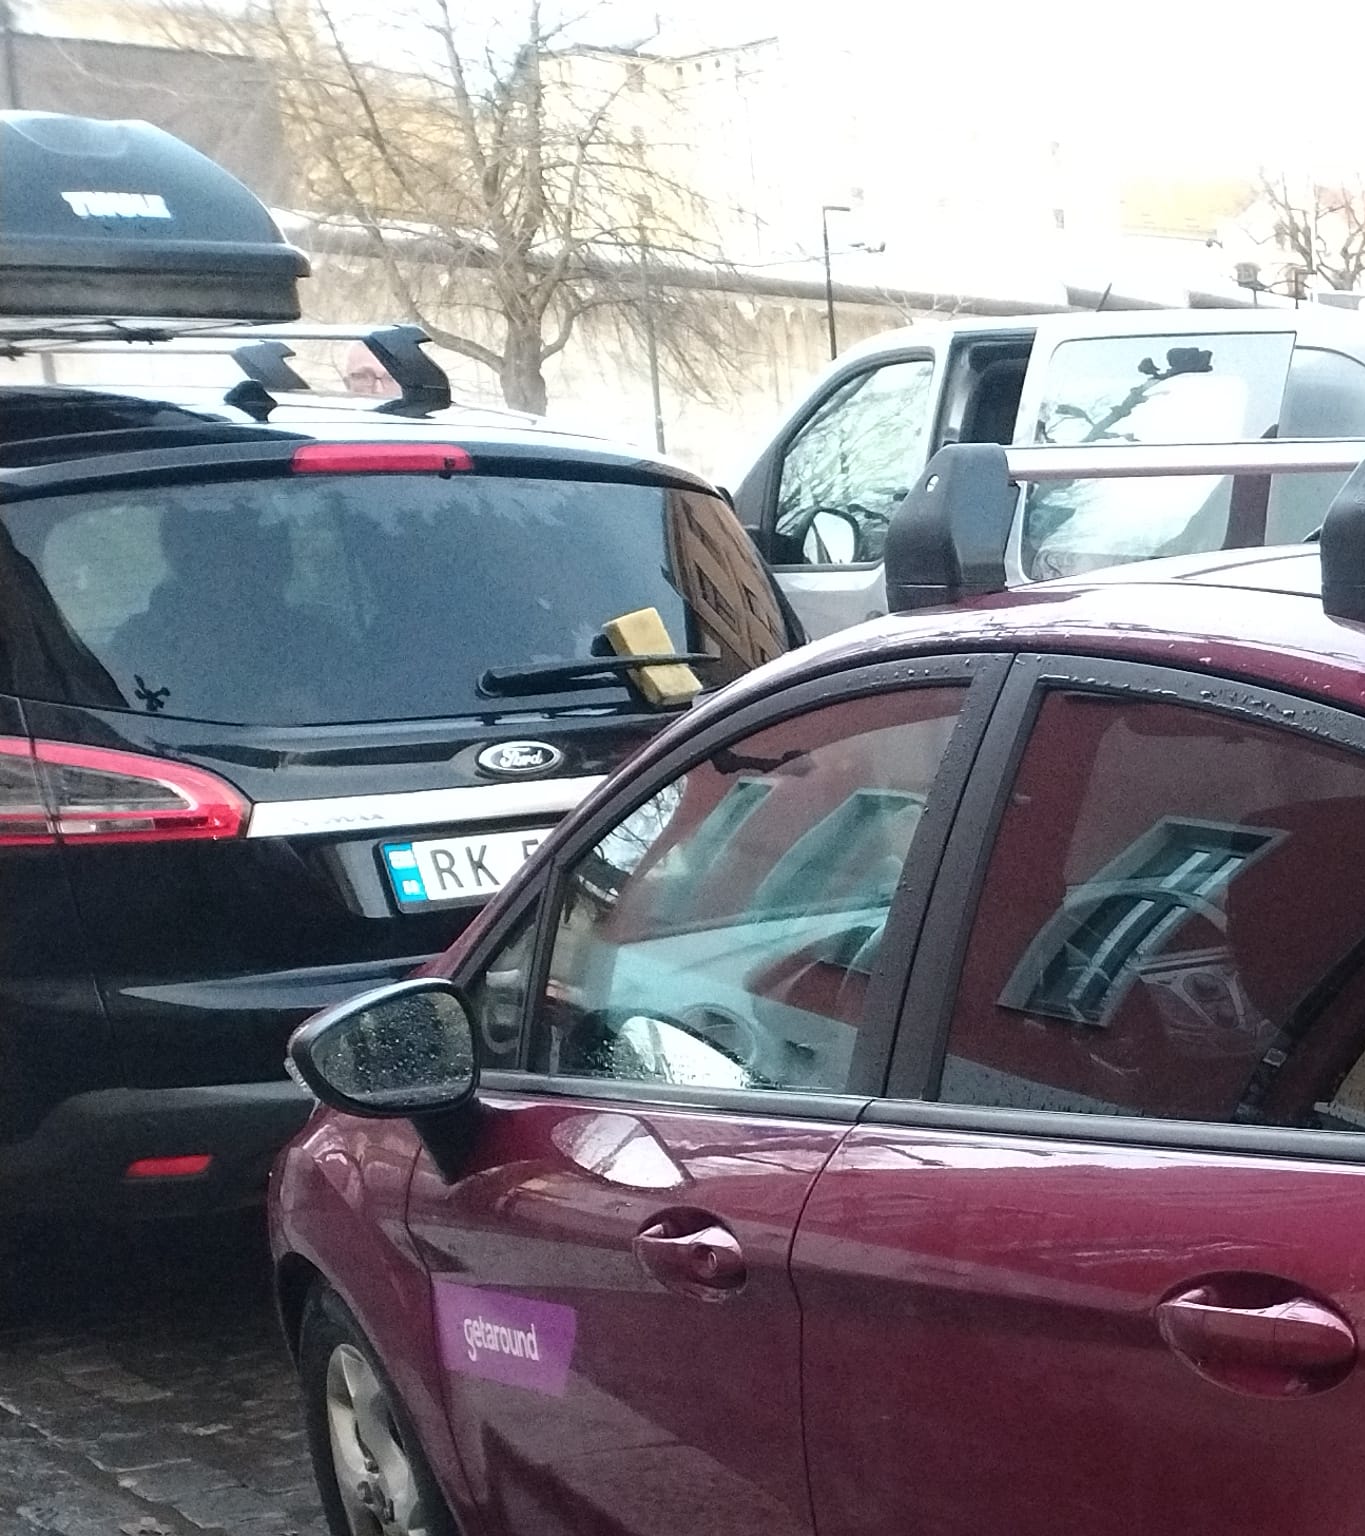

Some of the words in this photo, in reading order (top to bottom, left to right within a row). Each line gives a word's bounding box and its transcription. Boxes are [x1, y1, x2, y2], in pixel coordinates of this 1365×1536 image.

[500, 747, 543, 768] Ford
[429, 844, 501, 890] RK
[463, 1315, 540, 1362] getaround
